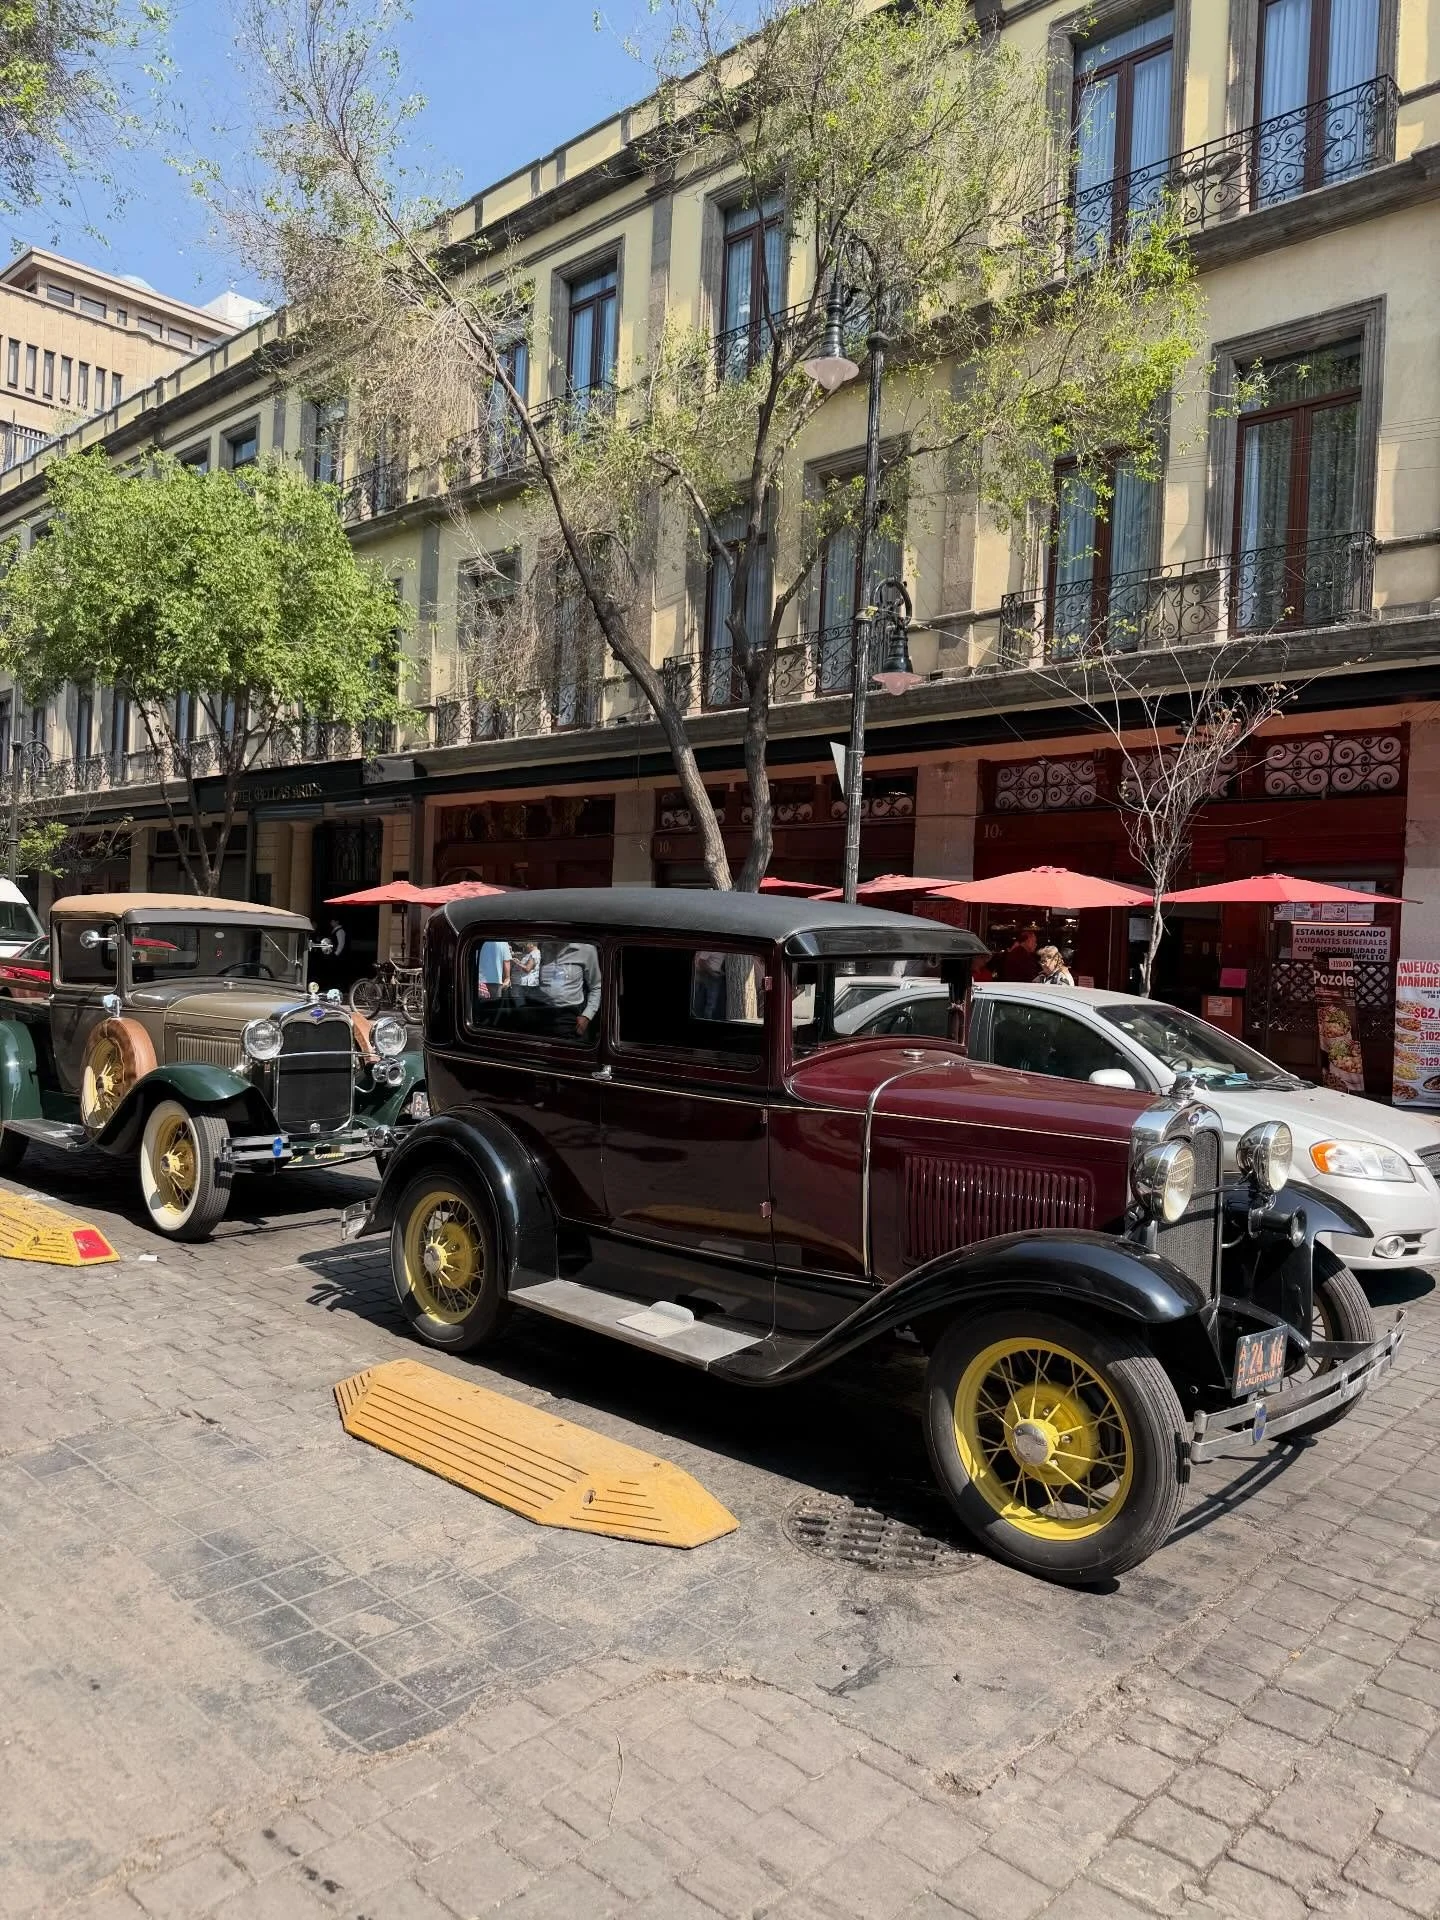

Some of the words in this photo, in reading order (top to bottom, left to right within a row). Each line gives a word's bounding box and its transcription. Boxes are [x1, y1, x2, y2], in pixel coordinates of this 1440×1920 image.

[1295, 928, 1335, 937] ESTAMOS
[1337, 929, 1386, 938] BUSCANDO
[1294, 937, 1340, 945] AYUDANTES
[1342, 938, 1388, 946] GENERALES
[1315, 946, 1376, 955] DISPONIBILIDAD
[1313, 970, 1354, 987] Pozole
[1398, 974, 1440, 988] MAÑANE
